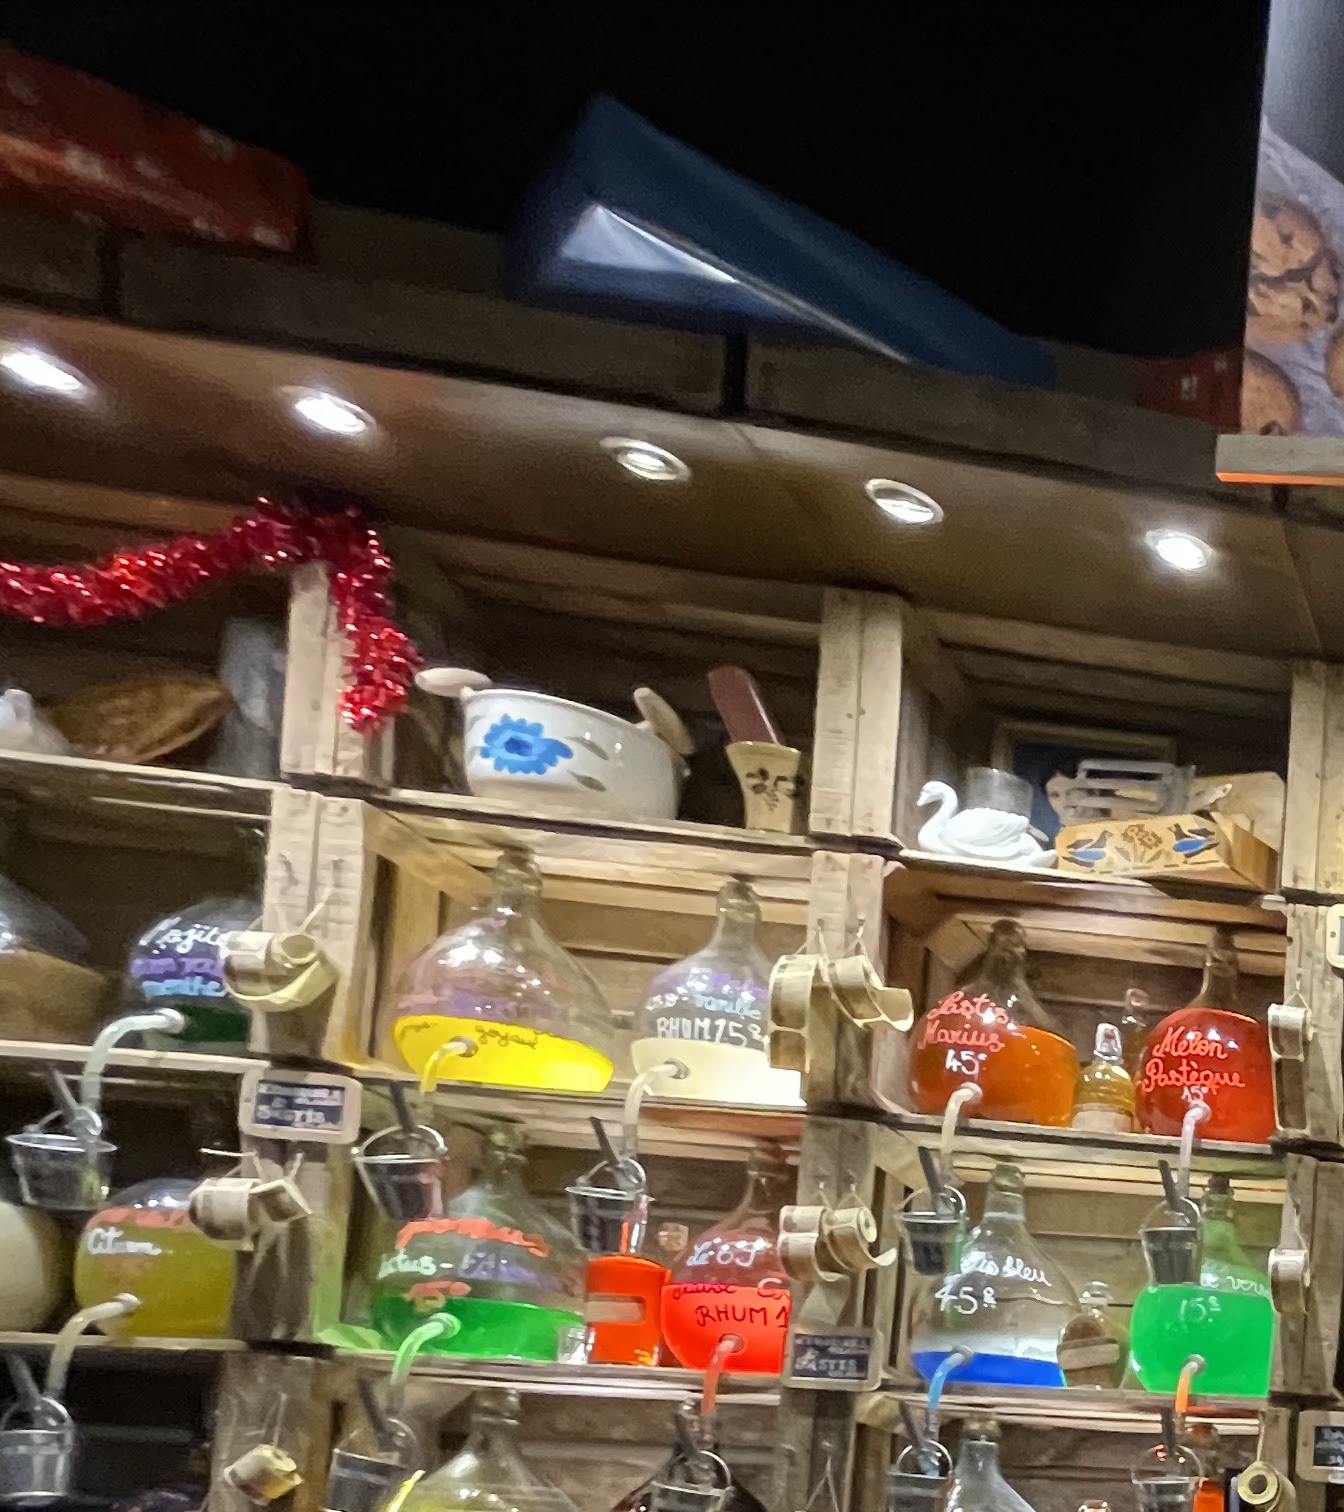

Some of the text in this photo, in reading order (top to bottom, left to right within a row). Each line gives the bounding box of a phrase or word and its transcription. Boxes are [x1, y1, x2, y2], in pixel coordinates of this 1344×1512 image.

[656, 1017, 711, 1040] RHUM
[917, 1020, 1005, 1052] Marius
[1152, 1026, 1228, 1059] Melon
[1141, 1058, 1246, 1095] Pastèque
[695, 1303, 768, 1328] RHUM
